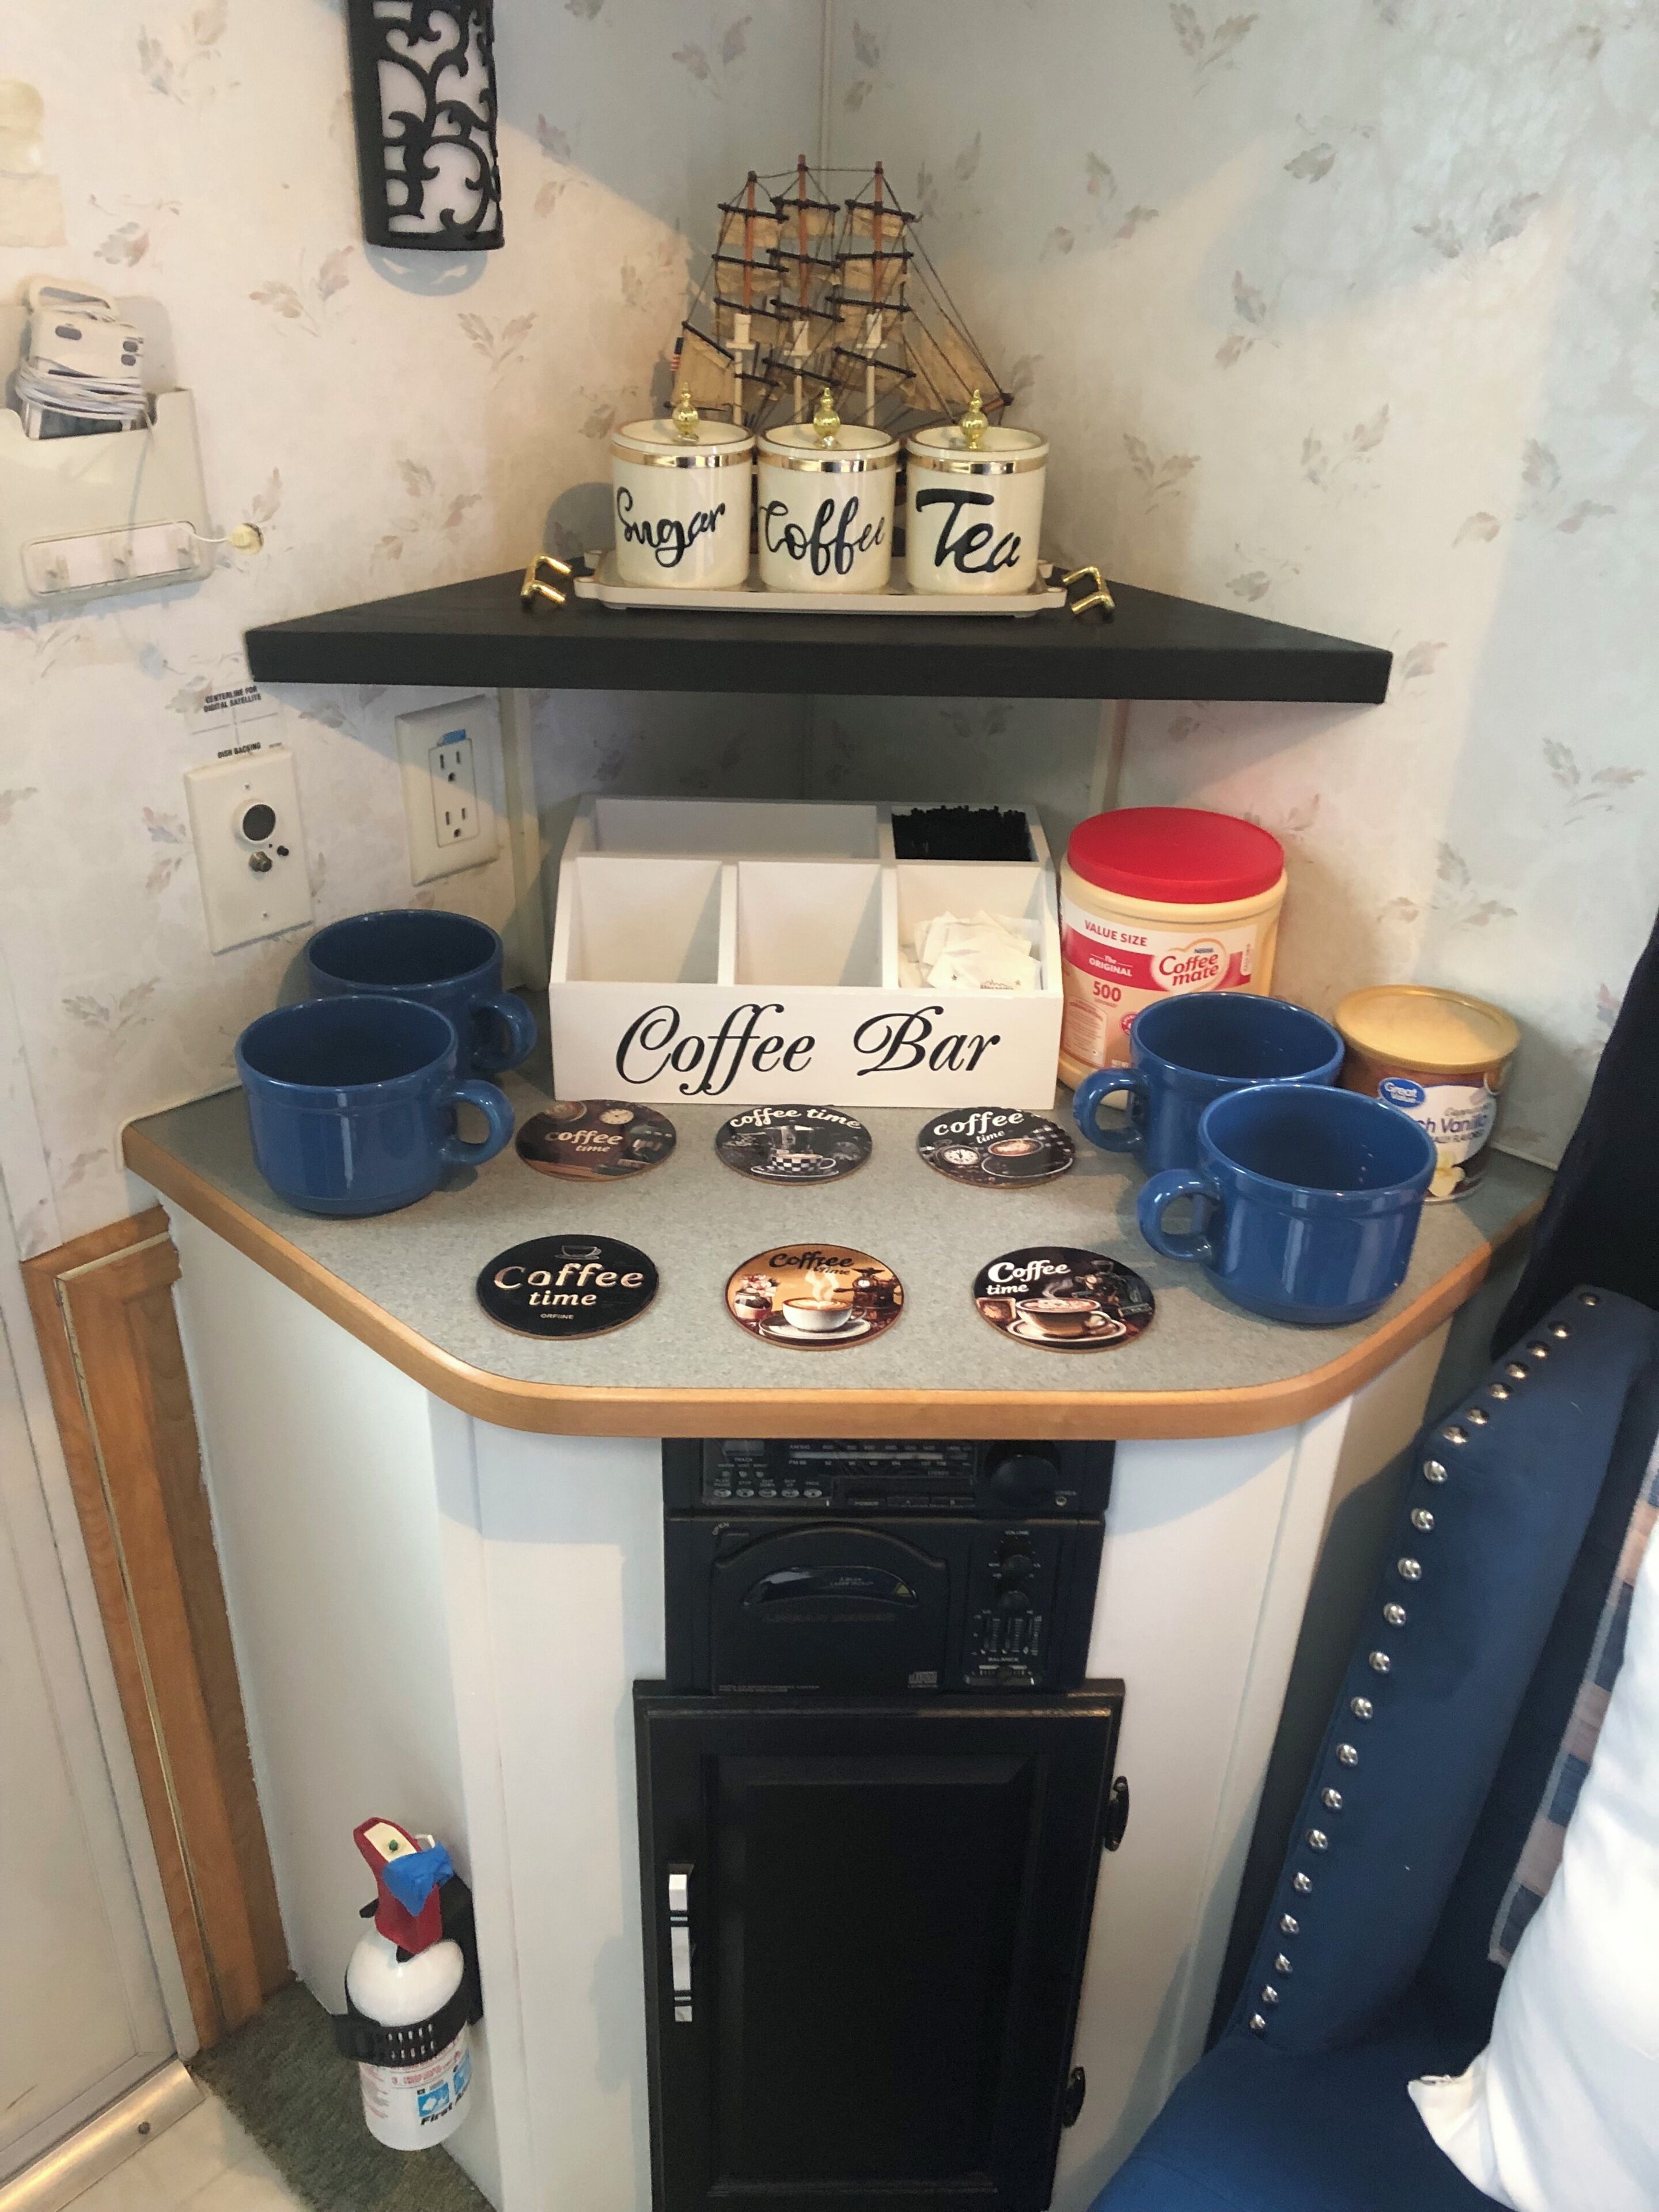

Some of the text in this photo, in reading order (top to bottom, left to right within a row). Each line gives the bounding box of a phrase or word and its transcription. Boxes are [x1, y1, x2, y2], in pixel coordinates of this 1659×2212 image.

[616, 486, 726, 568] Sugar
[759, 495, 885, 576] Coffee
[915, 488, 1022, 574] Tea
[203, 693, 262, 713] DIGITAL SATELLITE
[205, 685, 257, 703] CENTERLINE FOR
[217, 749, 233, 759] DISH
[233, 741, 261, 755] BACKING
[1085, 919, 1148, 947] VALUE SIZE
[1088, 957, 1133, 978] ORIGINAL
[1104, 955, 1118, 964] The
[1158, 953, 1219, 976] Coffee
[1172, 964, 1219, 986] mate
[1093, 980, 1122, 1002] 500
[615, 1003, 816, 1096] Coffee
[853, 1005, 1001, 1076] Bar
[1384, 1082, 1418, 1098] Great
[730, 1107, 862, 1129] coffee time
[933, 1111, 1025, 1136] coffee
[544, 1130, 623, 1145] coffee
[976, 1130, 1005, 1144] time
[575, 1144, 611, 1153] time
[768, 1251, 855, 1270] Coffee
[987, 1259, 1071, 1283] Coffee
[494, 1262, 644, 1290] Coffee
[529, 1290, 597, 1306] time
[986, 1284, 1029, 1296] time
[421, 2102, 453, 2126] First
